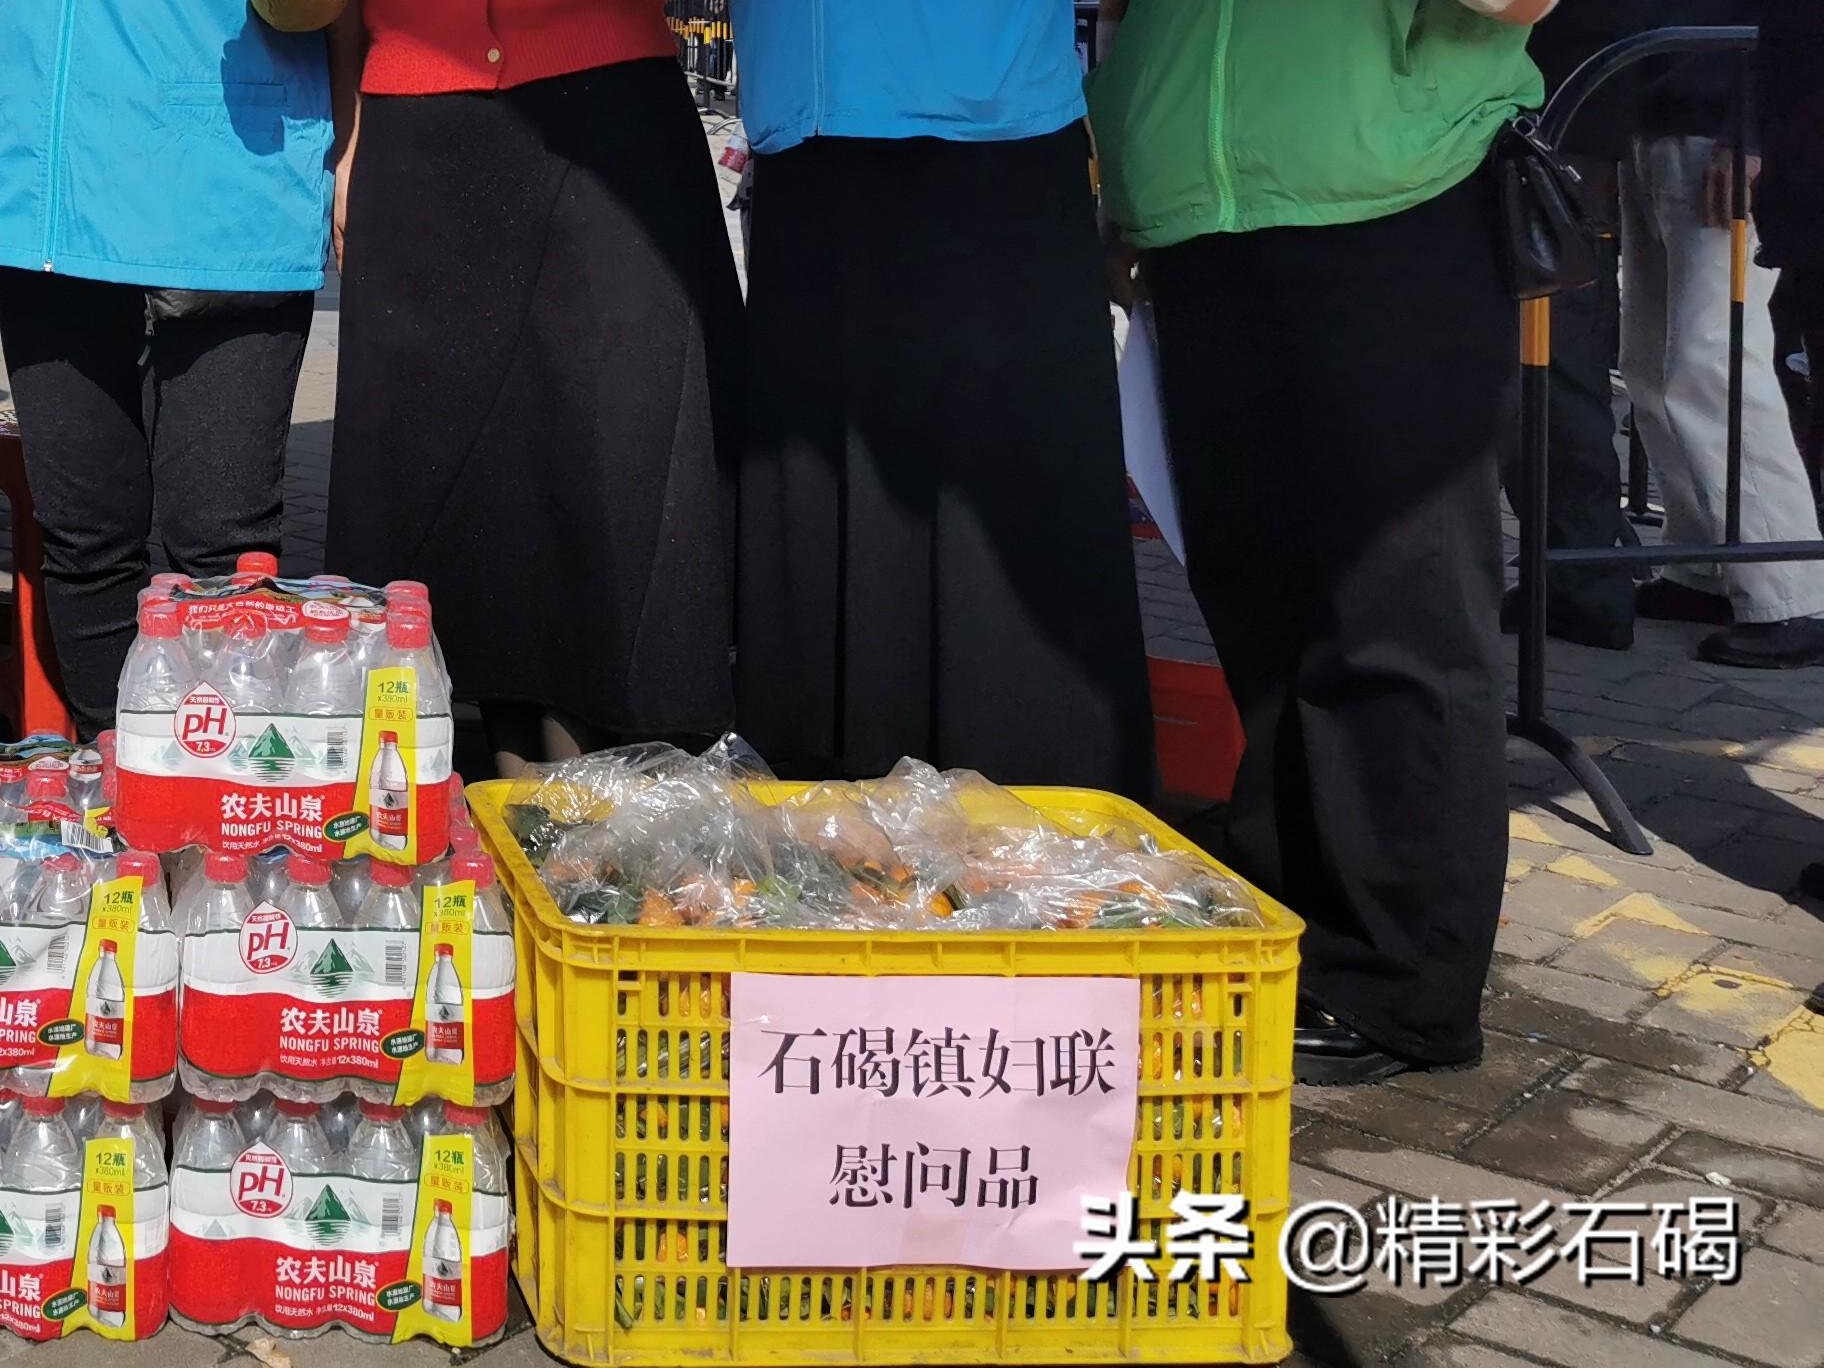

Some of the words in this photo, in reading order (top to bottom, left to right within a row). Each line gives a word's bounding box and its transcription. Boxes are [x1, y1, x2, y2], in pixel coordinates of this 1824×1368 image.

[377, 681, 409, 694] 12瓶
[182, 706, 227, 741] pH
[220, 792, 323, 822] 农夫山泉
[221, 821, 272, 837] NONGFU
[275, 820, 323, 839] SPRING
[103, 891, 134, 905] 12瓶
[434, 895, 467, 909] 12瓶
[247, 922, 289, 961] pH
[280, 1007, 380, 1037] 农夫山泉
[279, 1036, 330, 1053] NONGFU
[333, 1036, 380, 1054] SPRING
[757, 1026, 1117, 1099] 石碣镇妇联
[96, 1152, 126, 1166] 12瓶
[434, 1150, 465, 1165] 12瓶
[238, 1165, 285, 1201] pH
[828, 1141, 1039, 1209] 慰问品
[275, 1255, 377, 1288] 农夫山泉
[275, 1285, 325, 1302] NONGFU
[328, 1284, 375, 1307] SPRING
